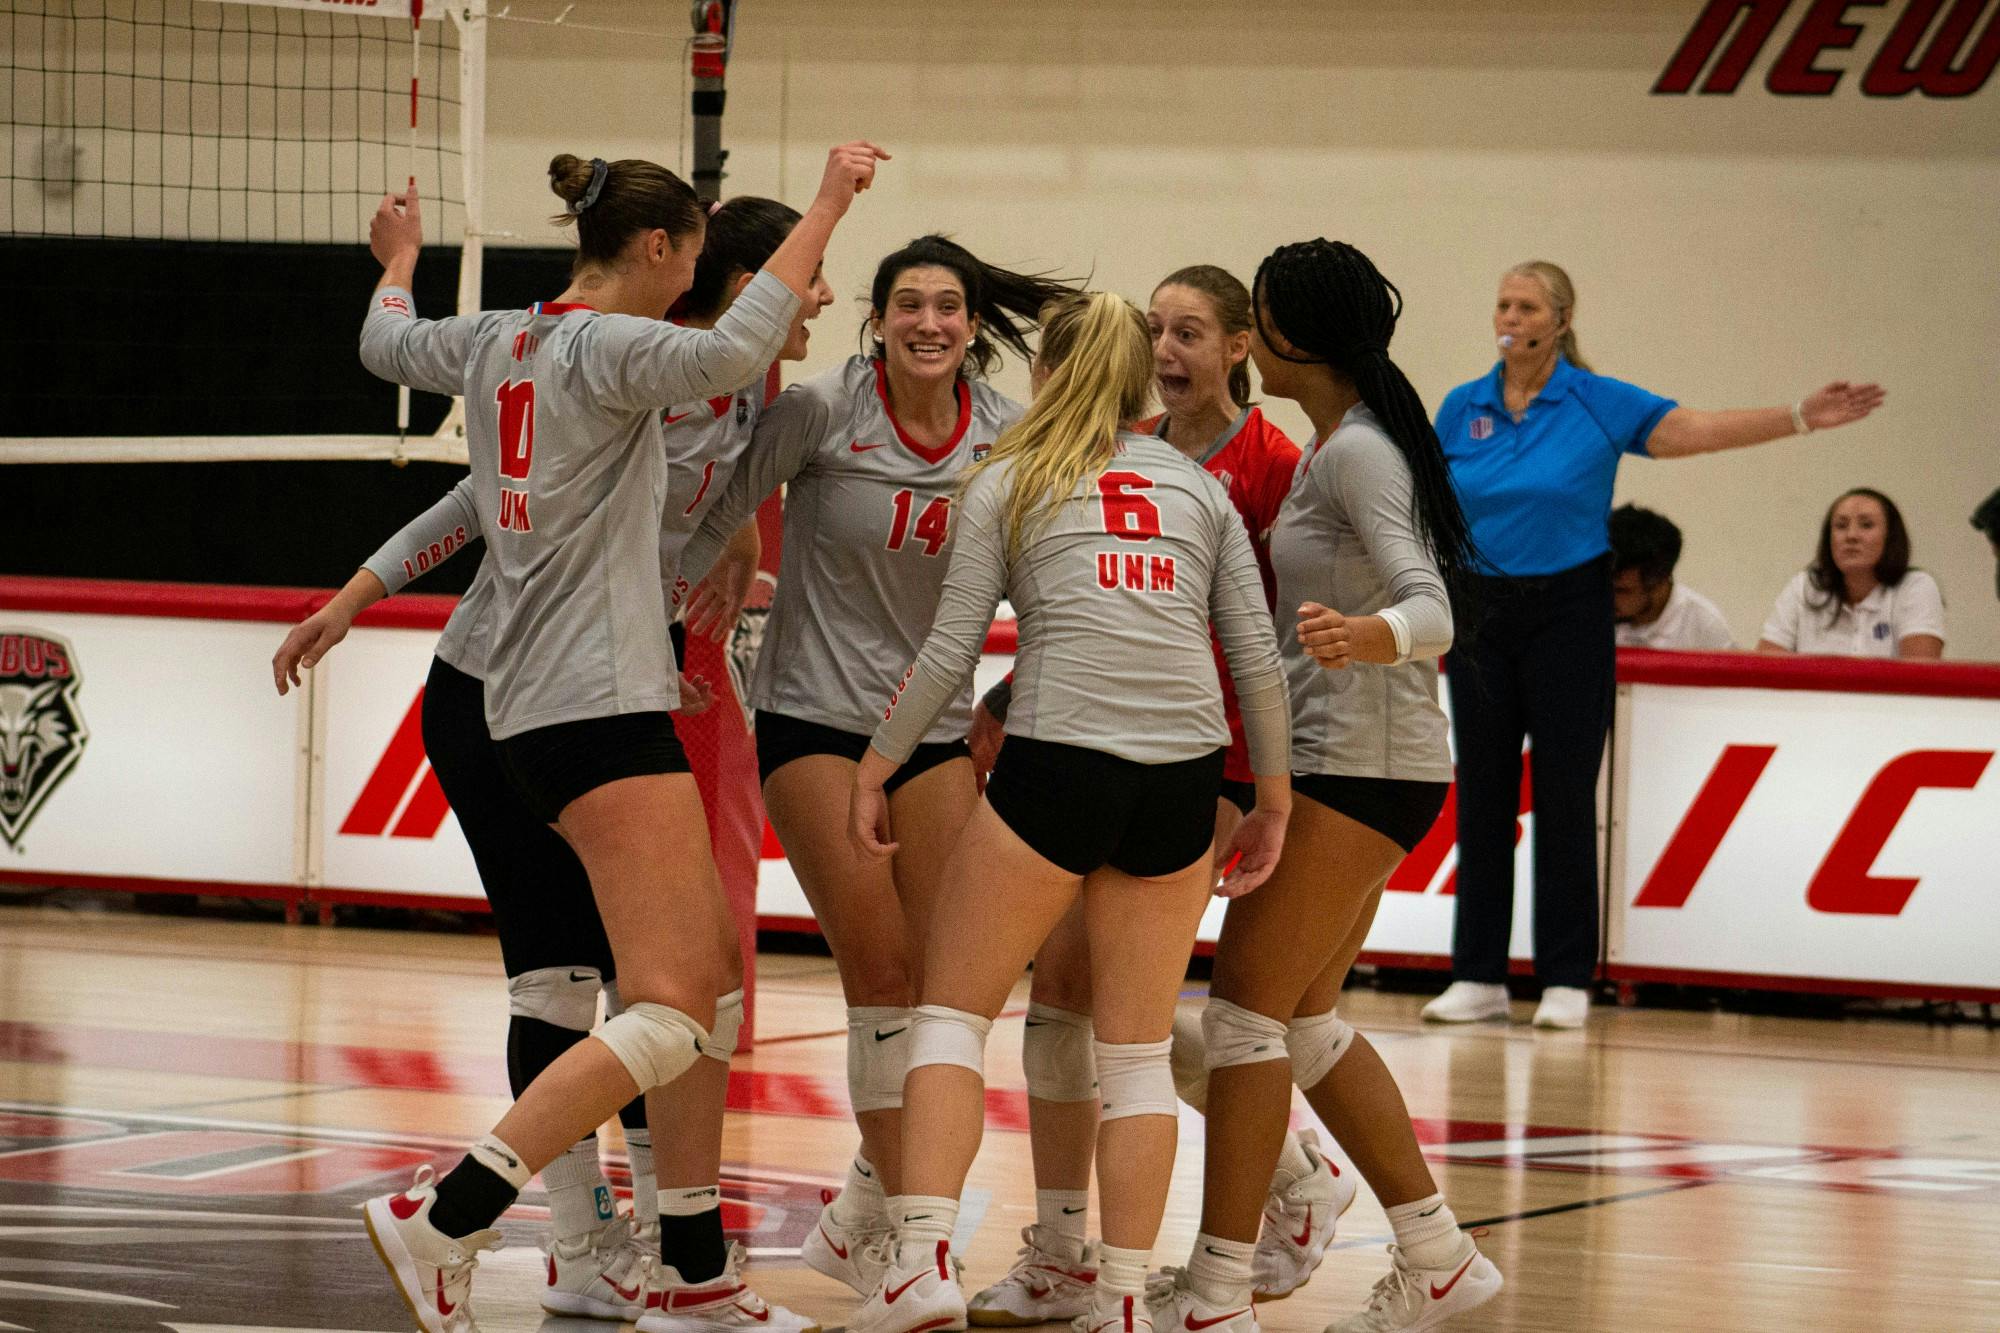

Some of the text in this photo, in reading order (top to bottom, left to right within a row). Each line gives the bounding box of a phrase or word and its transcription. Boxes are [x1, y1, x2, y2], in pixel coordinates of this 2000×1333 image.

[1650, 0, 2000, 98] NEW
[496, 376, 536, 481] 10
[683, 459, 719, 517] 1
[885, 487, 953, 558] 14
[1096, 470, 1164, 543] 6
[402, 525, 466, 580] LOBOS
[1095, 551, 1176, 594] UNM
